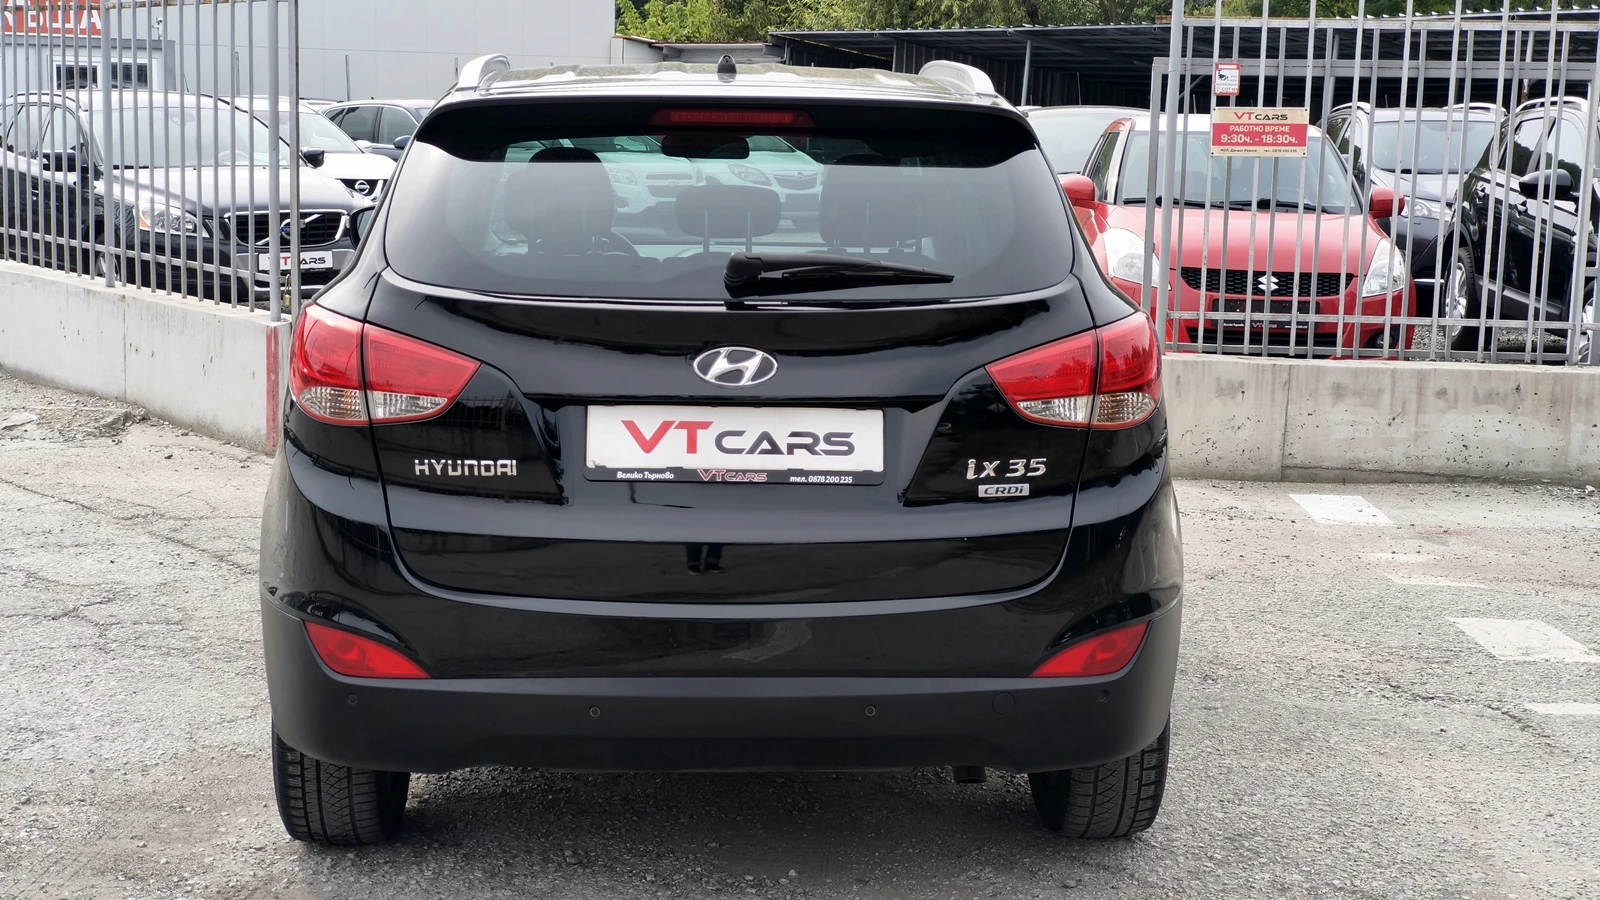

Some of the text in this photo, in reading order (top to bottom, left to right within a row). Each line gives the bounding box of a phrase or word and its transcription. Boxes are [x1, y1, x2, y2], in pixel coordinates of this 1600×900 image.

[1221, 134, 1253, 143] 9:30ч.
[1261, 134, 1299, 144] 18:30ч.
[300, 257, 326, 265] ARS
[414, 459, 517, 477] HYUNDAI
[1004, 458, 1047, 478] 35
[616, 471, 675, 480] Велико Търново
[808, 475, 826, 483] 0878
[840, 476, 853, 484] 235
[983, 486, 1024, 495] CRDi
